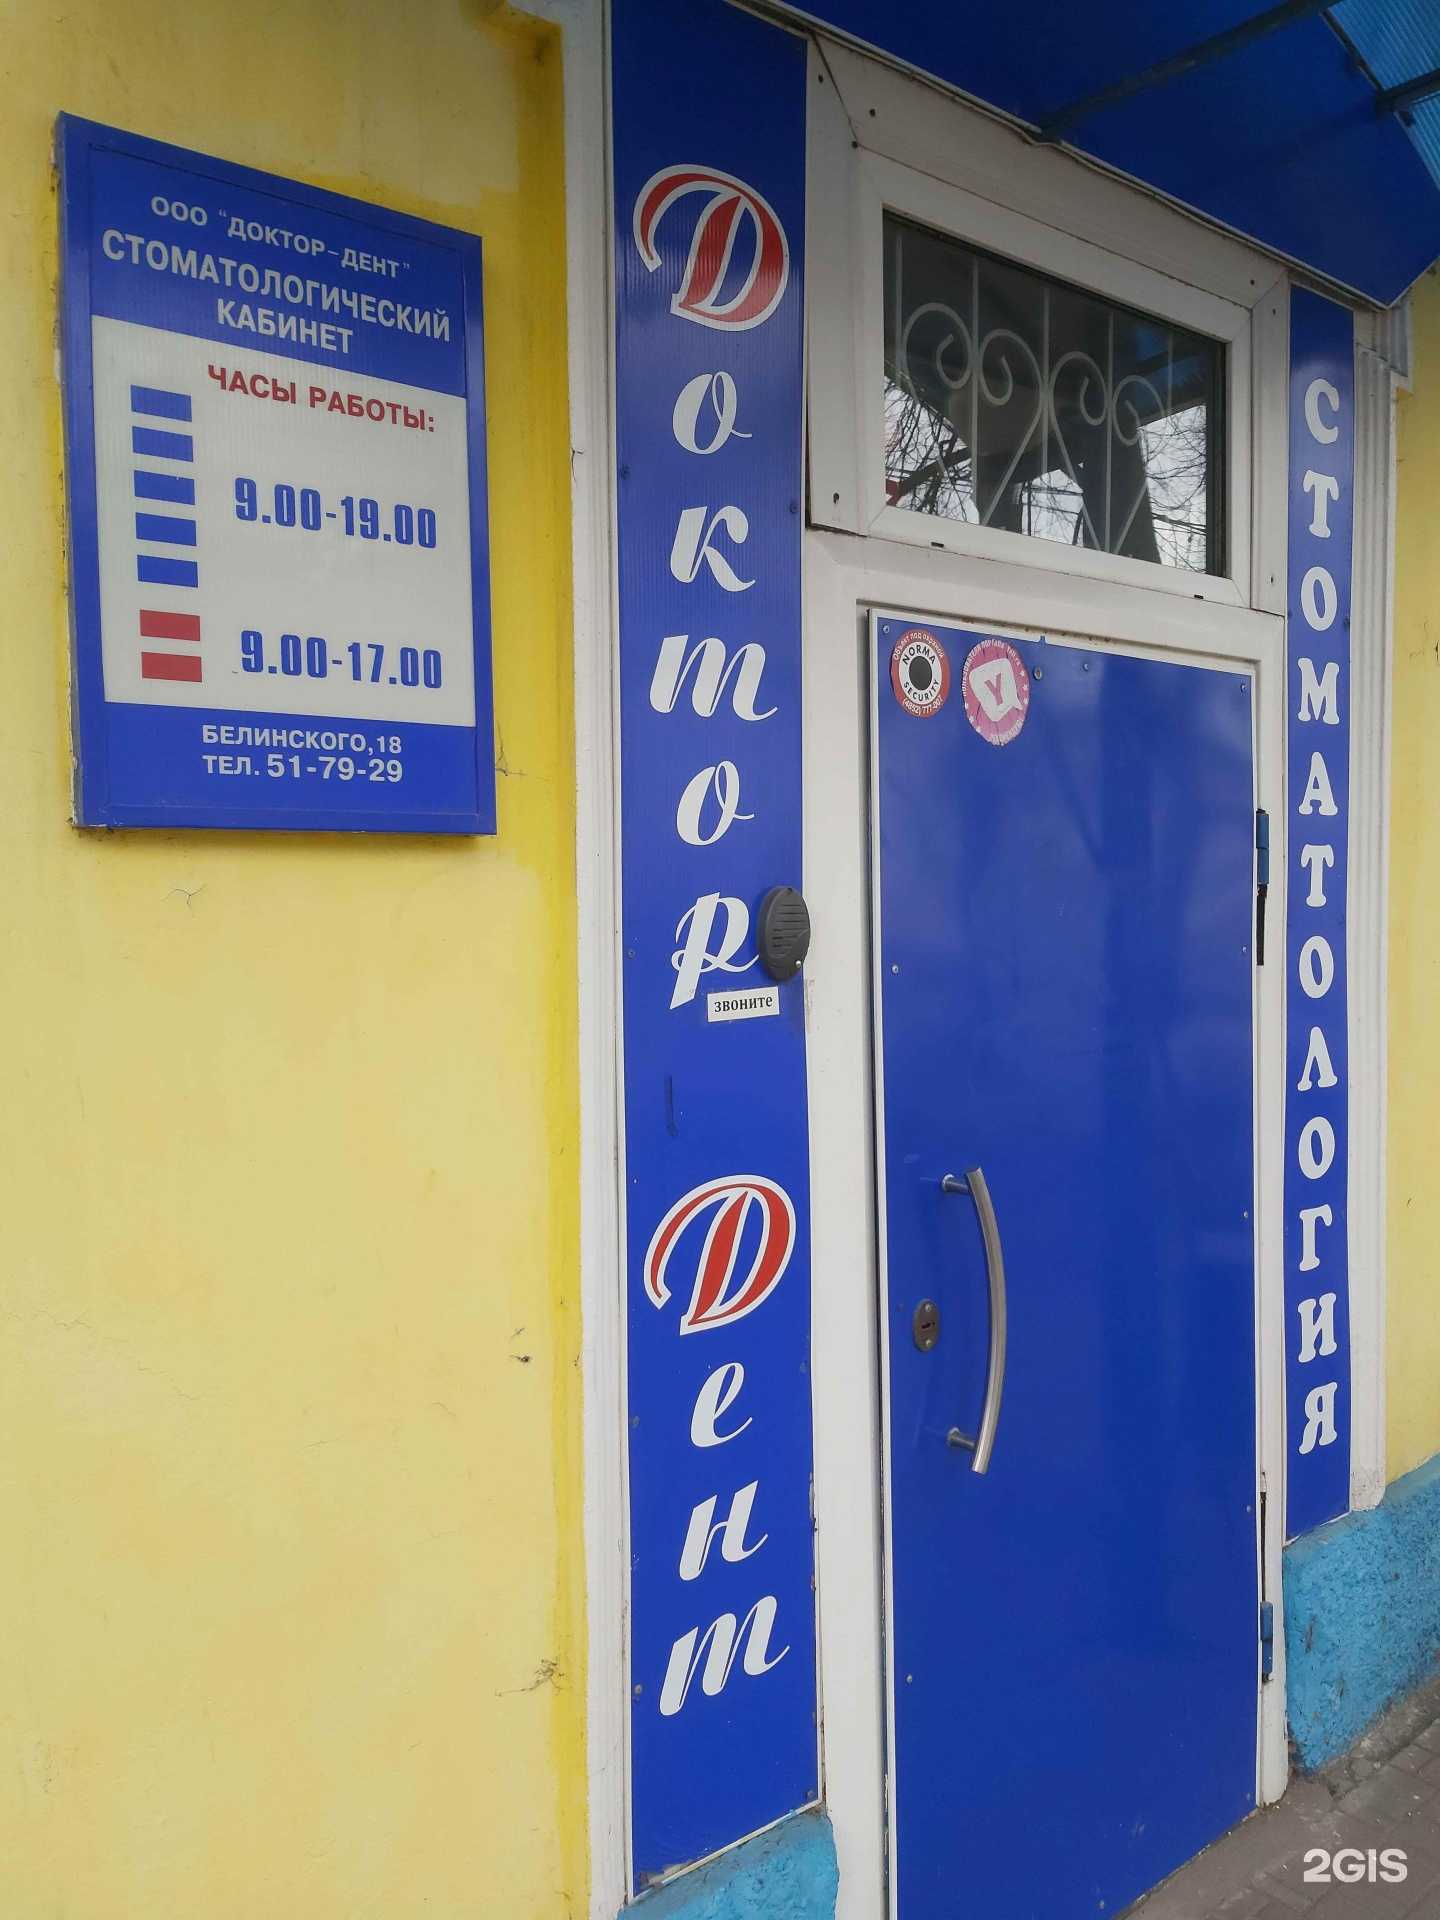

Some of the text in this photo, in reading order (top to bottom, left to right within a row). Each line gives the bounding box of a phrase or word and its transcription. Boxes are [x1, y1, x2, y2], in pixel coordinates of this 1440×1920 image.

[151, 196, 209, 227] ООО
[101, 228, 451, 342] СТОМАТОЛОГИЧЕСКИЙ
[216, 298, 353, 354] КАБИНЕТ
[207, 364, 436, 433] ЧАСЫ РАБОТЫ:
[234, 476, 437, 549] 9.00-19.00
[240, 629, 443, 689] 9.00-17.00
[902, 644, 936, 665] NORMA
[903, 679, 940, 702] SECURITY
[201, 724, 402, 755] БЕЛИНСКОГО,18
[201, 753, 404, 784] ТЕЛ. 51-79-29
[1296, 378, 1341, 1454] СТОМАТОЛОГИЯ
[714, 996, 773, 1013] звоните
